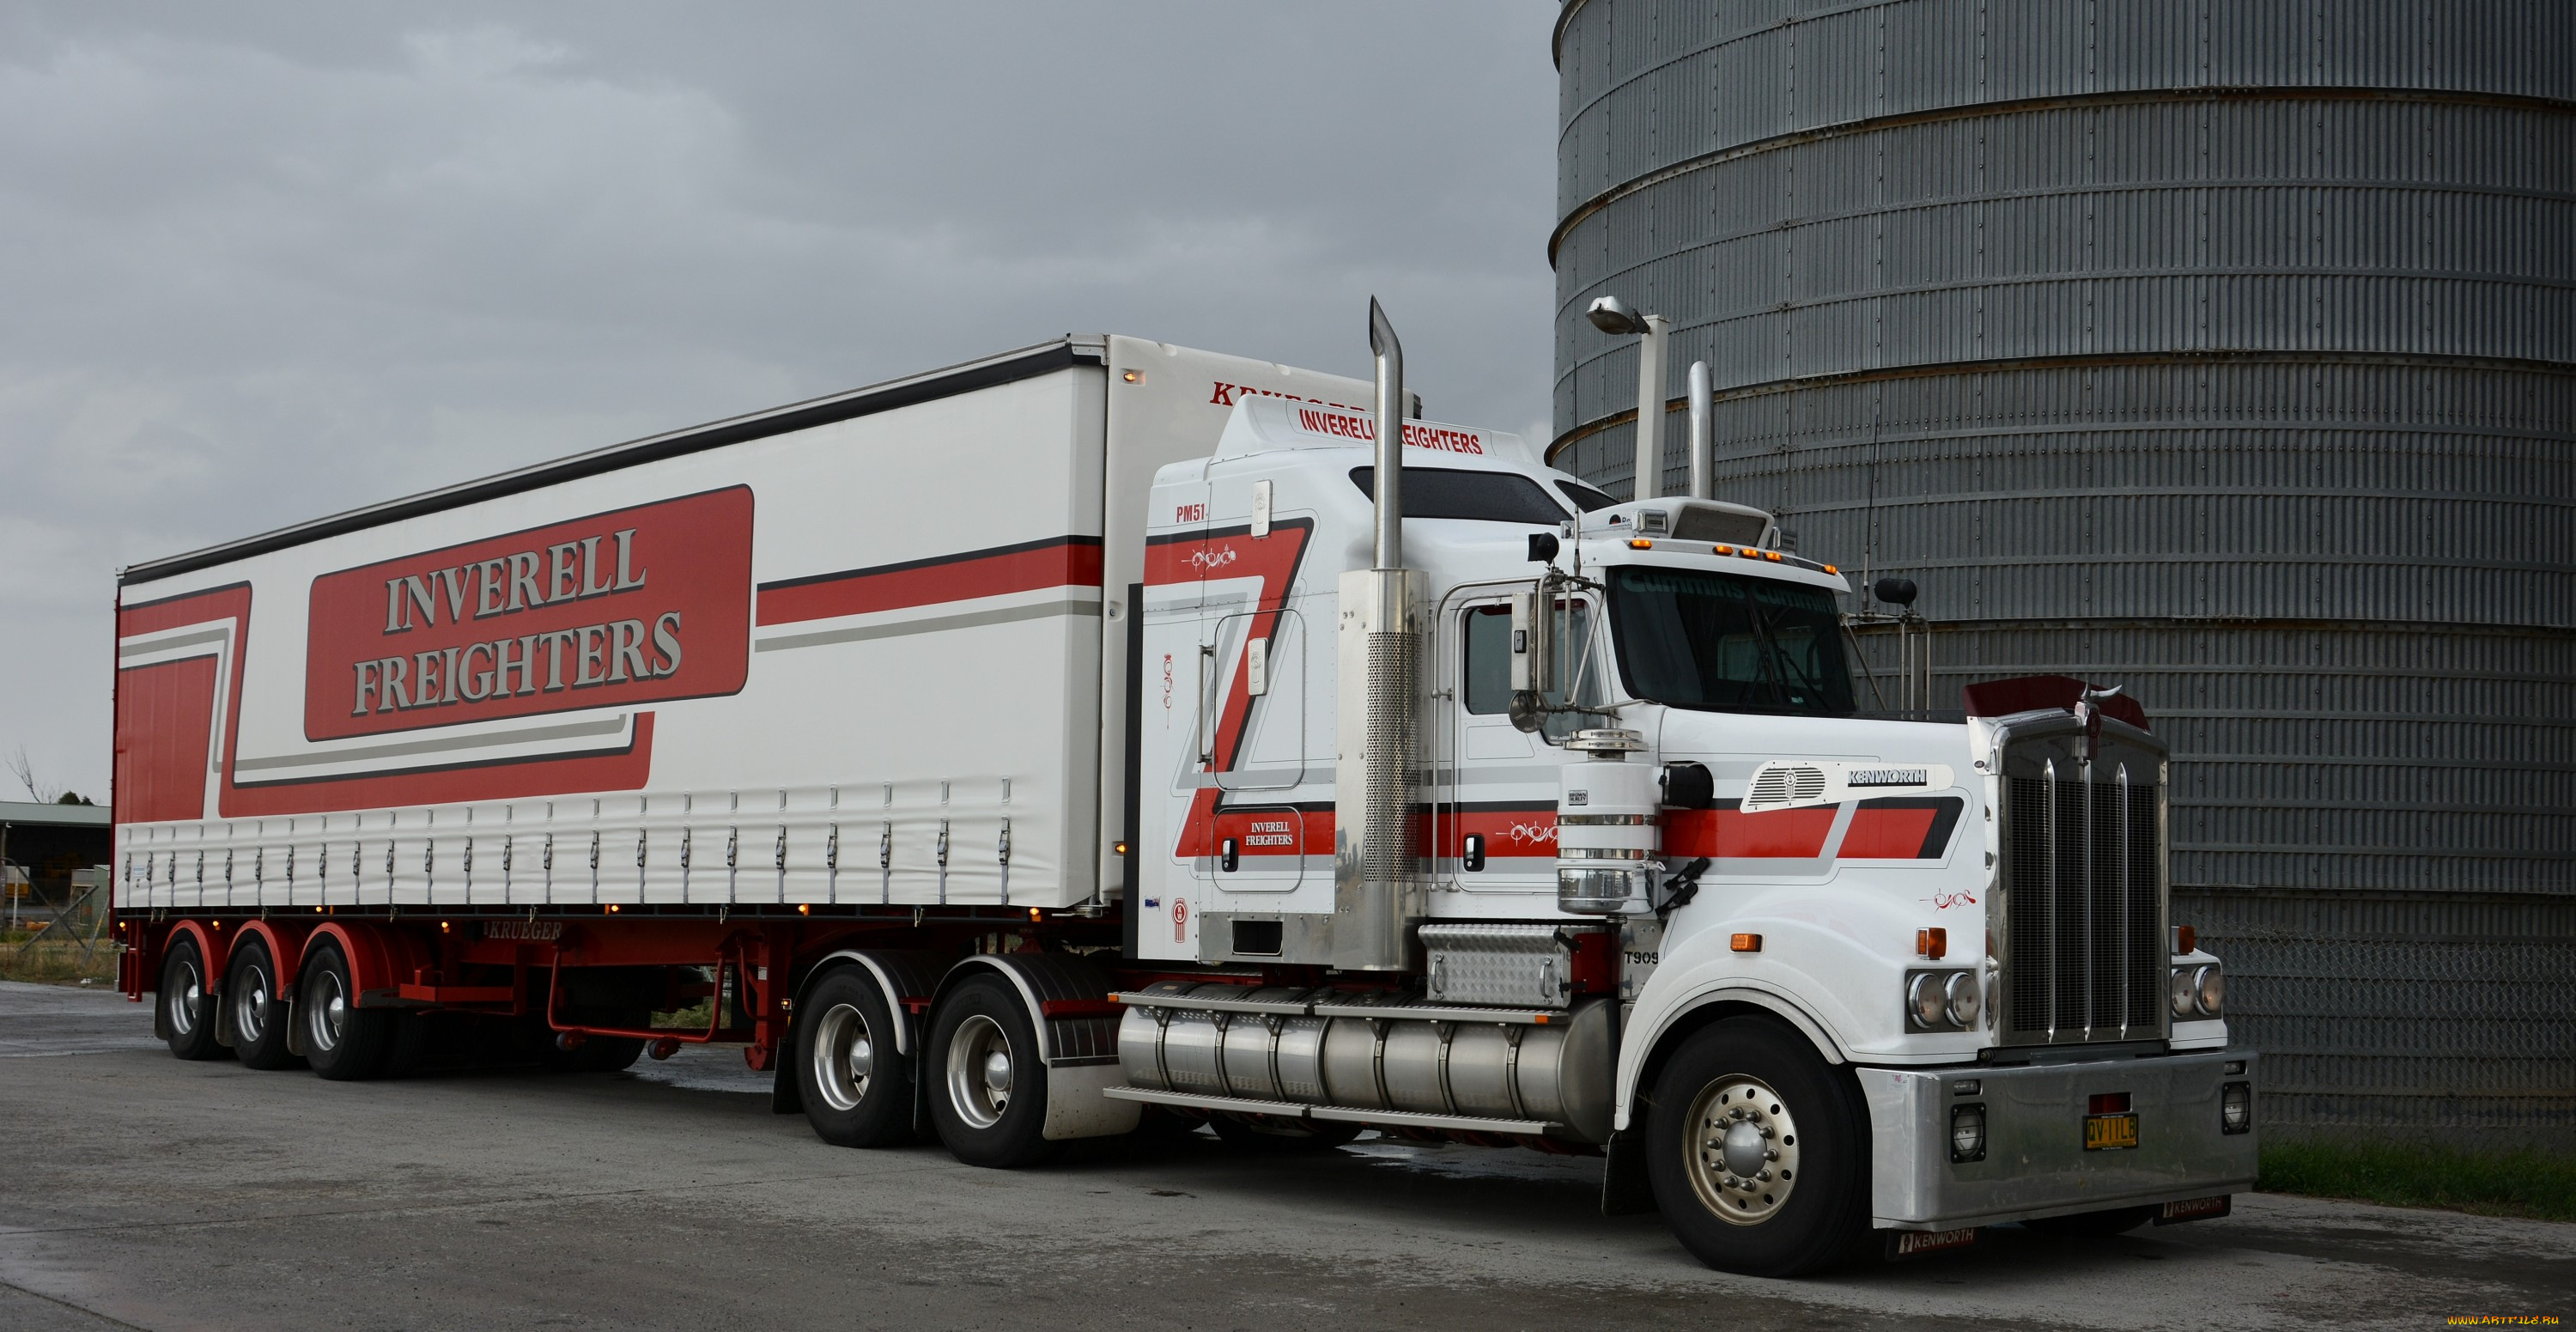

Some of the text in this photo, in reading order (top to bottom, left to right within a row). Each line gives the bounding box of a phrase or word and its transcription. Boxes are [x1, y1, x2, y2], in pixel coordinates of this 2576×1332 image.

[1401, 424, 1483, 455] EIGHTERS
[1176, 503, 1205, 523] PM51
[385, 529, 647, 634] INVERELL
[1621, 569, 1746, 600] Cummins
[353, 611, 681, 715] FREIGHTERS
[1848, 769, 1927, 783] KENWORTH
[1251, 821, 1290, 833] INVERELL
[1245, 834, 1293, 846] FREIGHTERS
[489, 921, 562, 940] KRUEGER
[1624, 952, 1659, 964] T909
[2175, 1196, 2222, 1213] KENWORTH
[1914, 1228, 1973, 1249] KENWORTH
